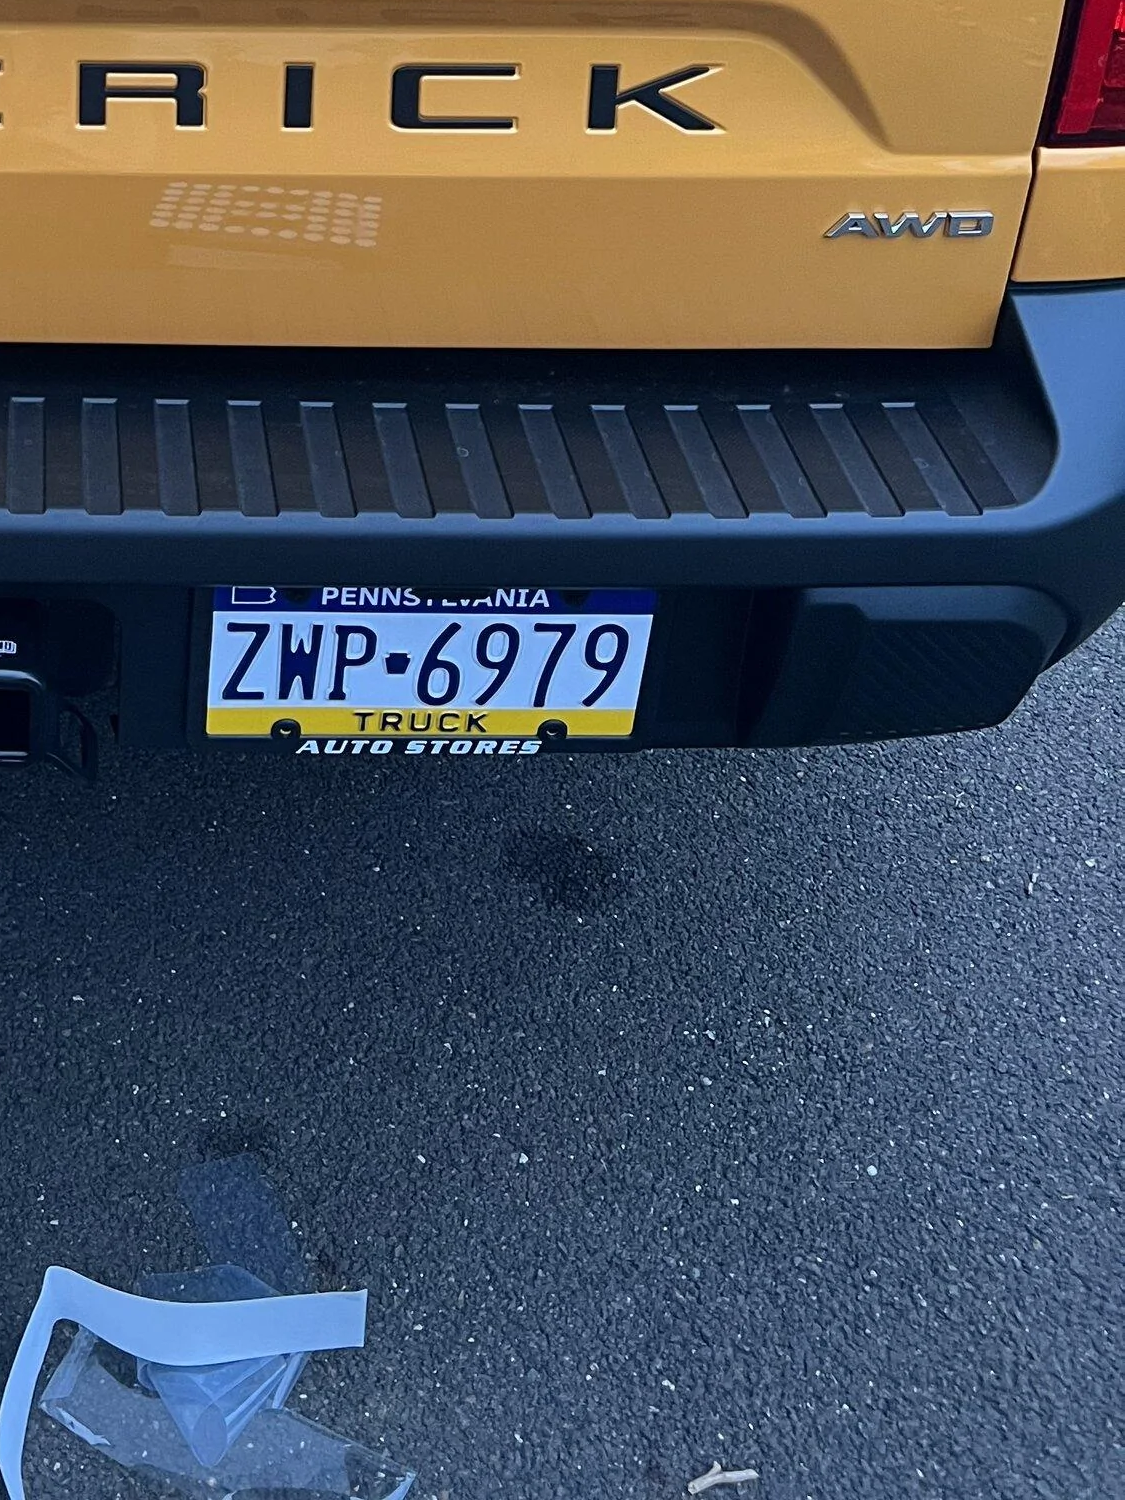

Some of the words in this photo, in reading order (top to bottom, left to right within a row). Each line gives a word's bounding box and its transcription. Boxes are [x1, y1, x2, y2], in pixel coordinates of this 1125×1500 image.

[823, 211, 995, 239] AWD
[353, 711, 488, 734] TRUCK
[295, 740, 393, 755] AUTO
[404, 740, 543, 755] STORES
